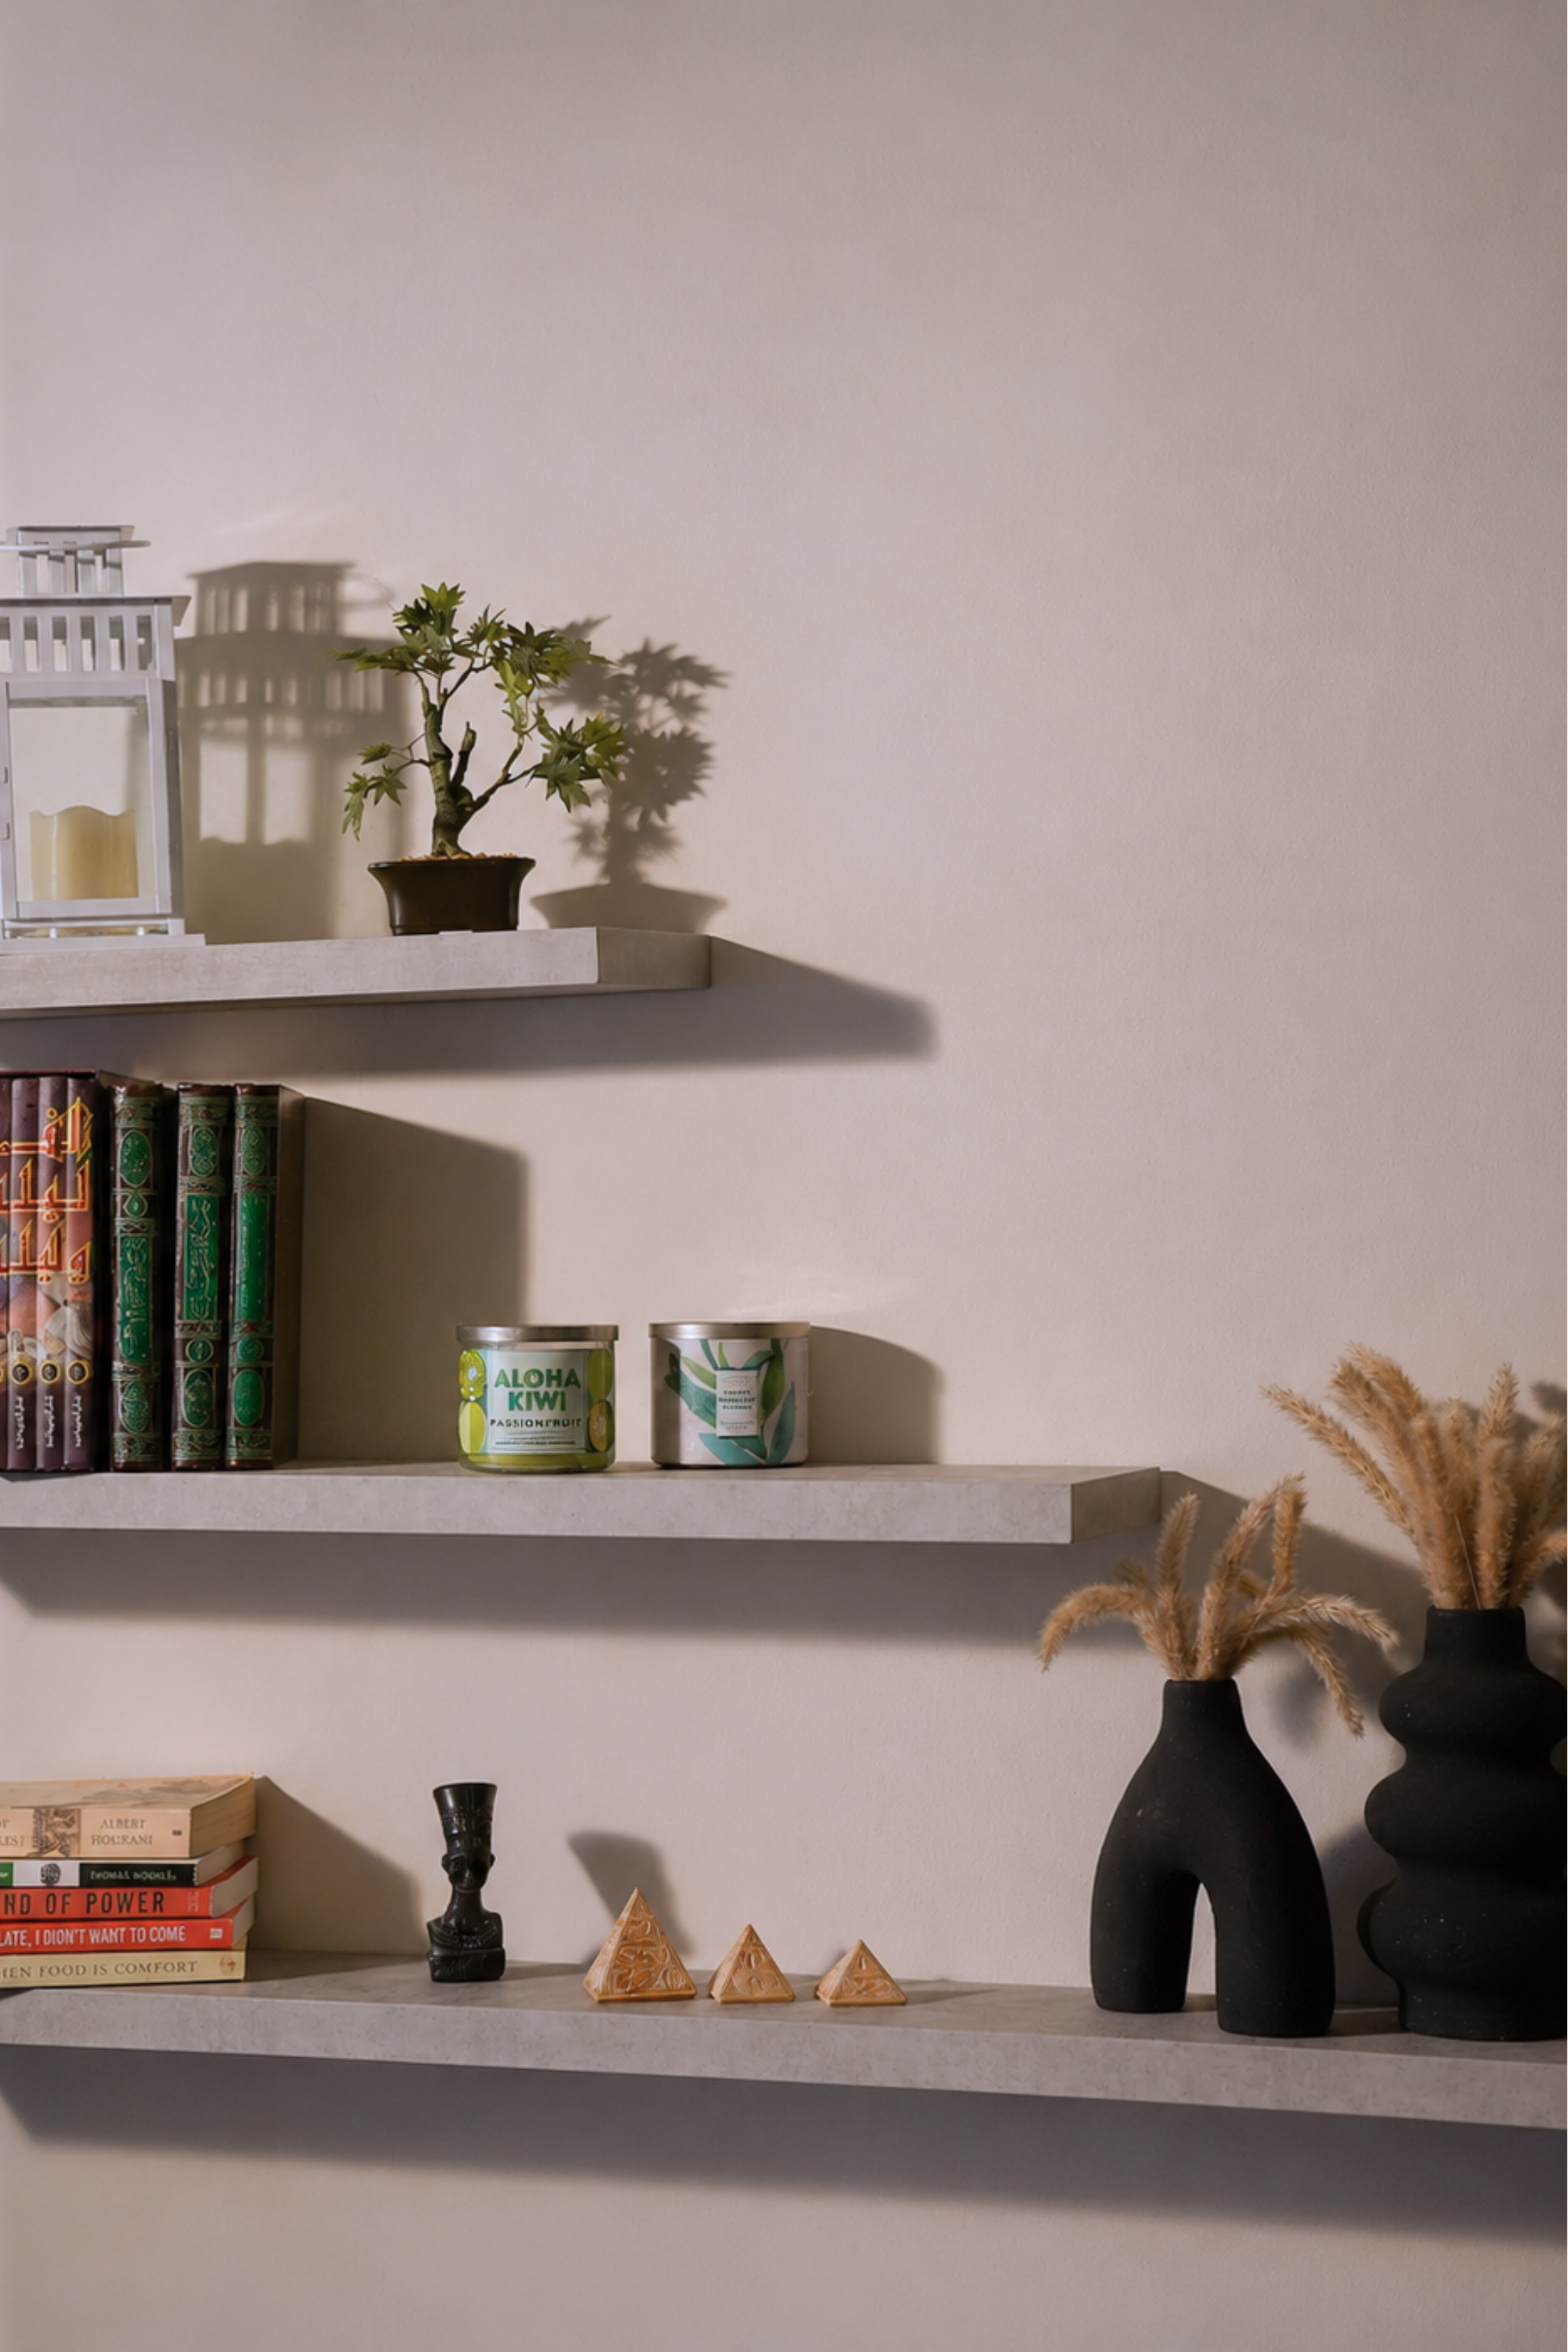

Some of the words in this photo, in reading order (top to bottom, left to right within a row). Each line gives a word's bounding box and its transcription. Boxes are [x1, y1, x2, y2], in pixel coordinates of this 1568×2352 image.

[494, 1368, 581, 1388] ALOHA
[508, 1390, 567, 1411] KIWI
[490, 1419, 582, 1428] PASSIONFRUIT
[100, 1818, 145, 1829] ALBERT
[91, 1835, 153, 1845] HOURANI
[45, 1893, 72, 1914] OF
[86, 1891, 164, 1914] POWER
[36, 1929, 40, 1946] I
[43, 1928, 85, 1945] DIDN'T
[89, 1928, 126, 1944] WANT
[130, 1928, 146, 1943] TO
[150, 1926, 186, 1942] COME
[39, 1964, 87, 1976] FOOD
[93, 1964, 108, 1976] IS
[114, 1961, 198, 1975] COMFORT
